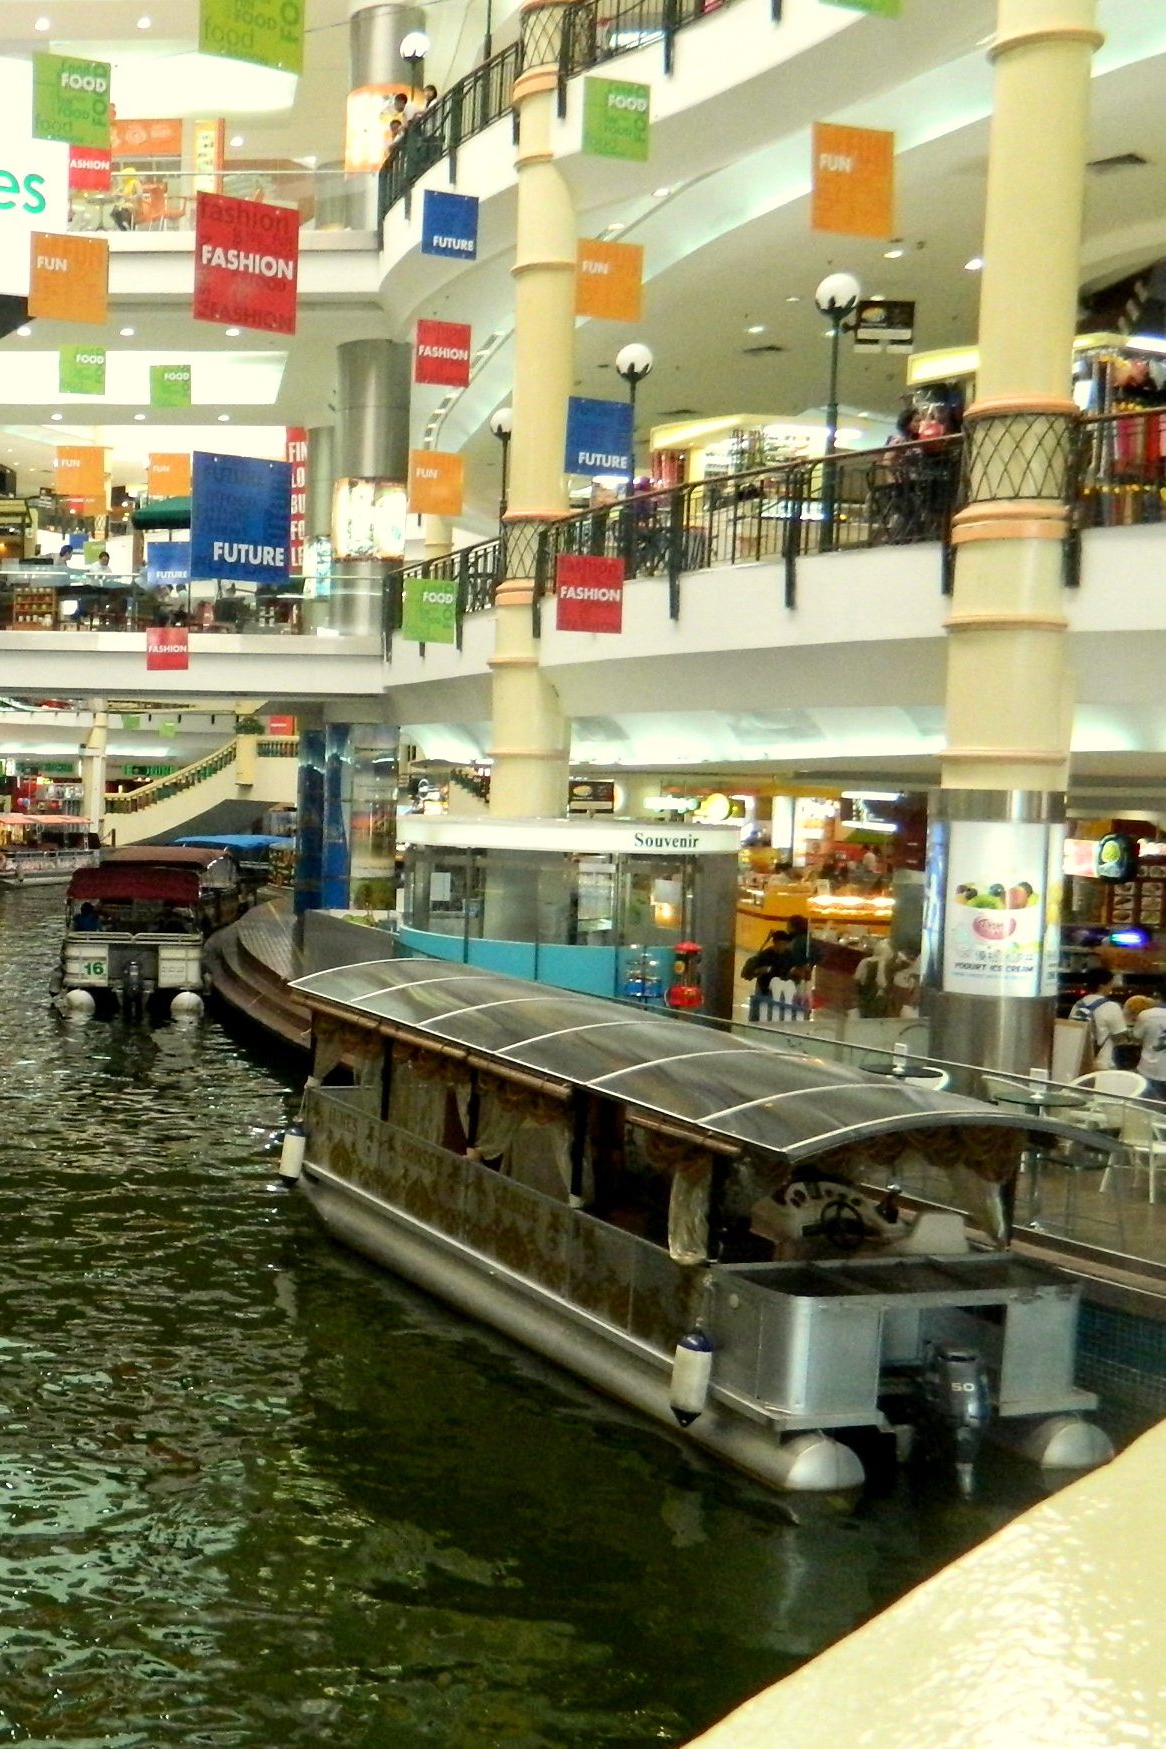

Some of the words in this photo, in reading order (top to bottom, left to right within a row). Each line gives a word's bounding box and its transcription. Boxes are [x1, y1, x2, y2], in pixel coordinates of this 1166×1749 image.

[61, 72, 106, 93] FOOD
[609, 94, 647, 112] FOOD
[70, 158, 109, 170] ASHION
[819, 153, 851, 173] FUN
[433, 235, 474, 251] FUTURE
[37, 255, 67, 272] FUN
[202, 245, 293, 280] FASHION
[582, 260, 609, 275] FUN
[76, 354, 104, 364] FOOD
[419, 345, 468, 361] FASHION
[164, 372, 190, 381] FOOD
[62, 459, 81, 468] FUN
[578, 451, 628, 470] FUTURE
[416, 467, 438, 479] FUN
[213, 541, 284, 567] FUTURE
[156, 570, 188, 579] FUTURE
[423, 591, 453, 604] FOOD
[560, 586, 621, 603] FASHION
[147, 644, 188, 654] FASHION
[634, 832, 699, 849] Souvenir
[84, 961, 104, 976] 16
[954, 962, 987, 971] YOGURT
[989, 964, 1003, 972] ICE
[1005, 965, 1033, 973] CREAM
[951, 1382, 975, 1392] 50
